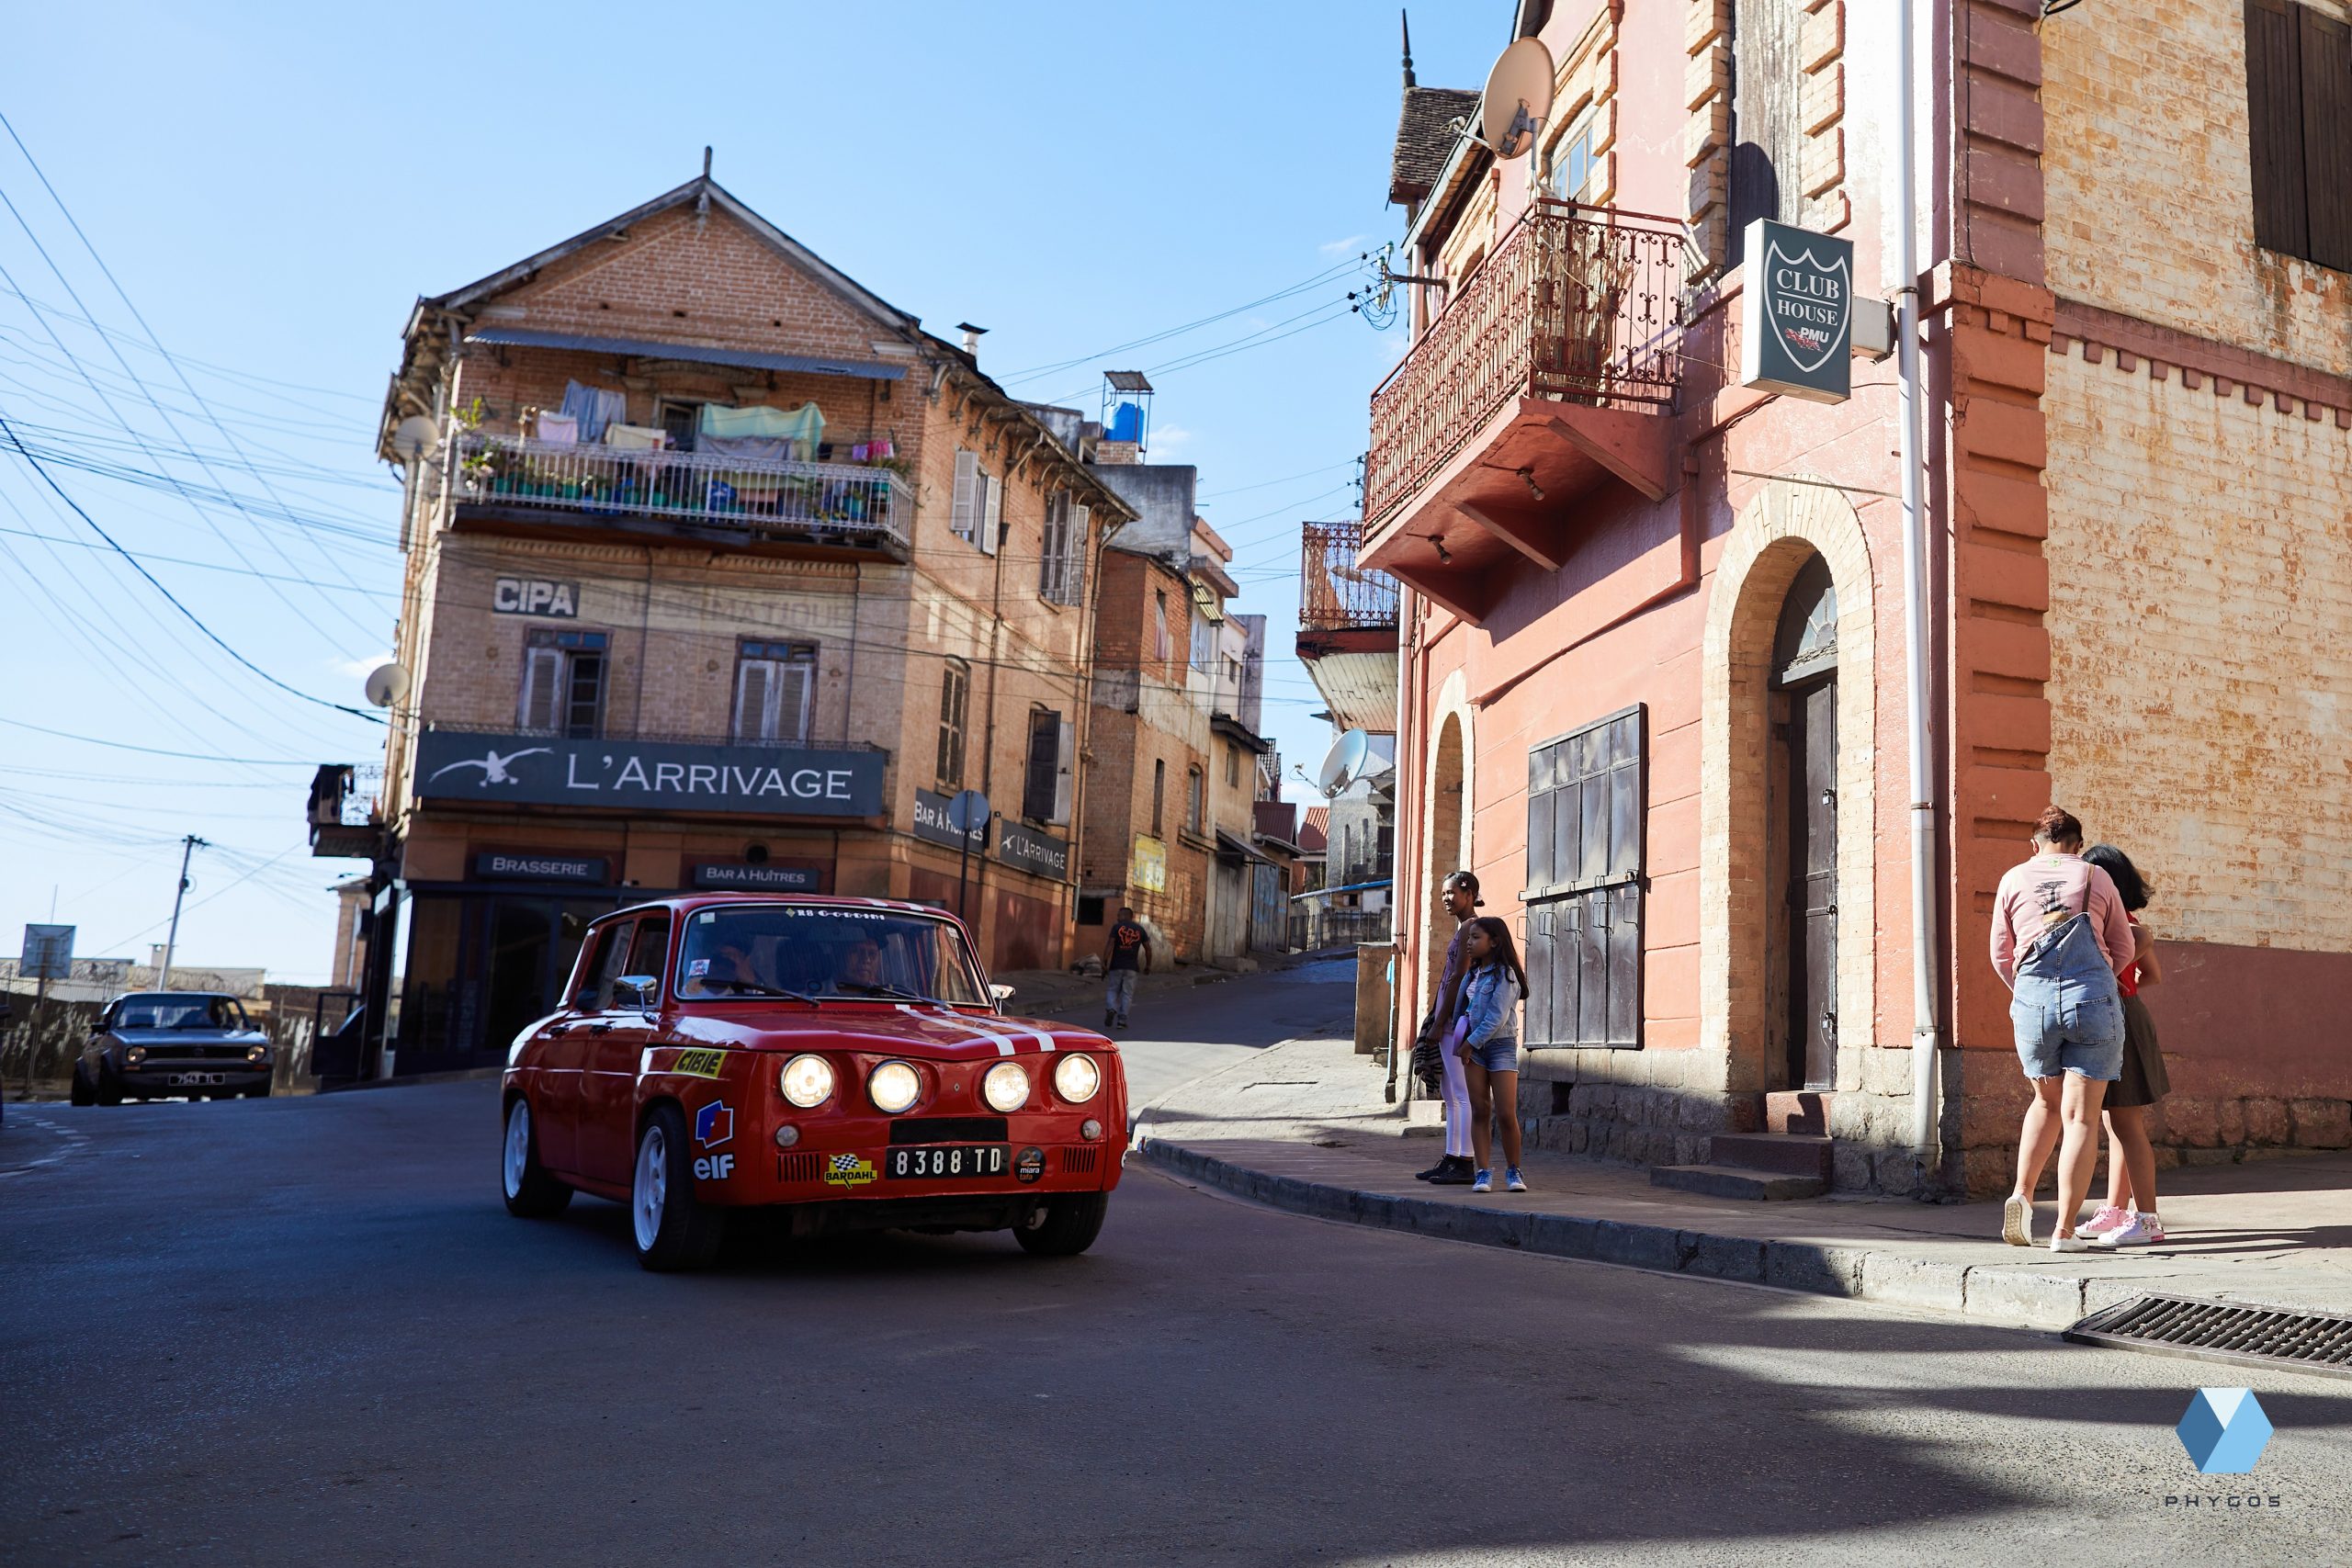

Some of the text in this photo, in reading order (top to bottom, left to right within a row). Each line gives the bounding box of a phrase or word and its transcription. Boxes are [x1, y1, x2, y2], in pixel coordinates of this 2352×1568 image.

[1776, 268, 1840, 299] CLUB
[1777, 299, 1838, 326] HOUSE
[1800, 326, 1830, 344] PMU
[493, 579, 574, 615] CIPA
[566, 753, 853, 800] L'ARRIVAGE
[913, 801, 934, 827] BAR
[492, 856, 588, 876] BRASSERIE
[1016, 836, 1066, 870] L'ARRIVAGE
[706, 866, 735, 880] BAR
[694, 1154, 735, 1180] elf
[896, 1147, 1001, 1176] 8388 TD
[825, 1170, 876, 1180] BARDAHL
